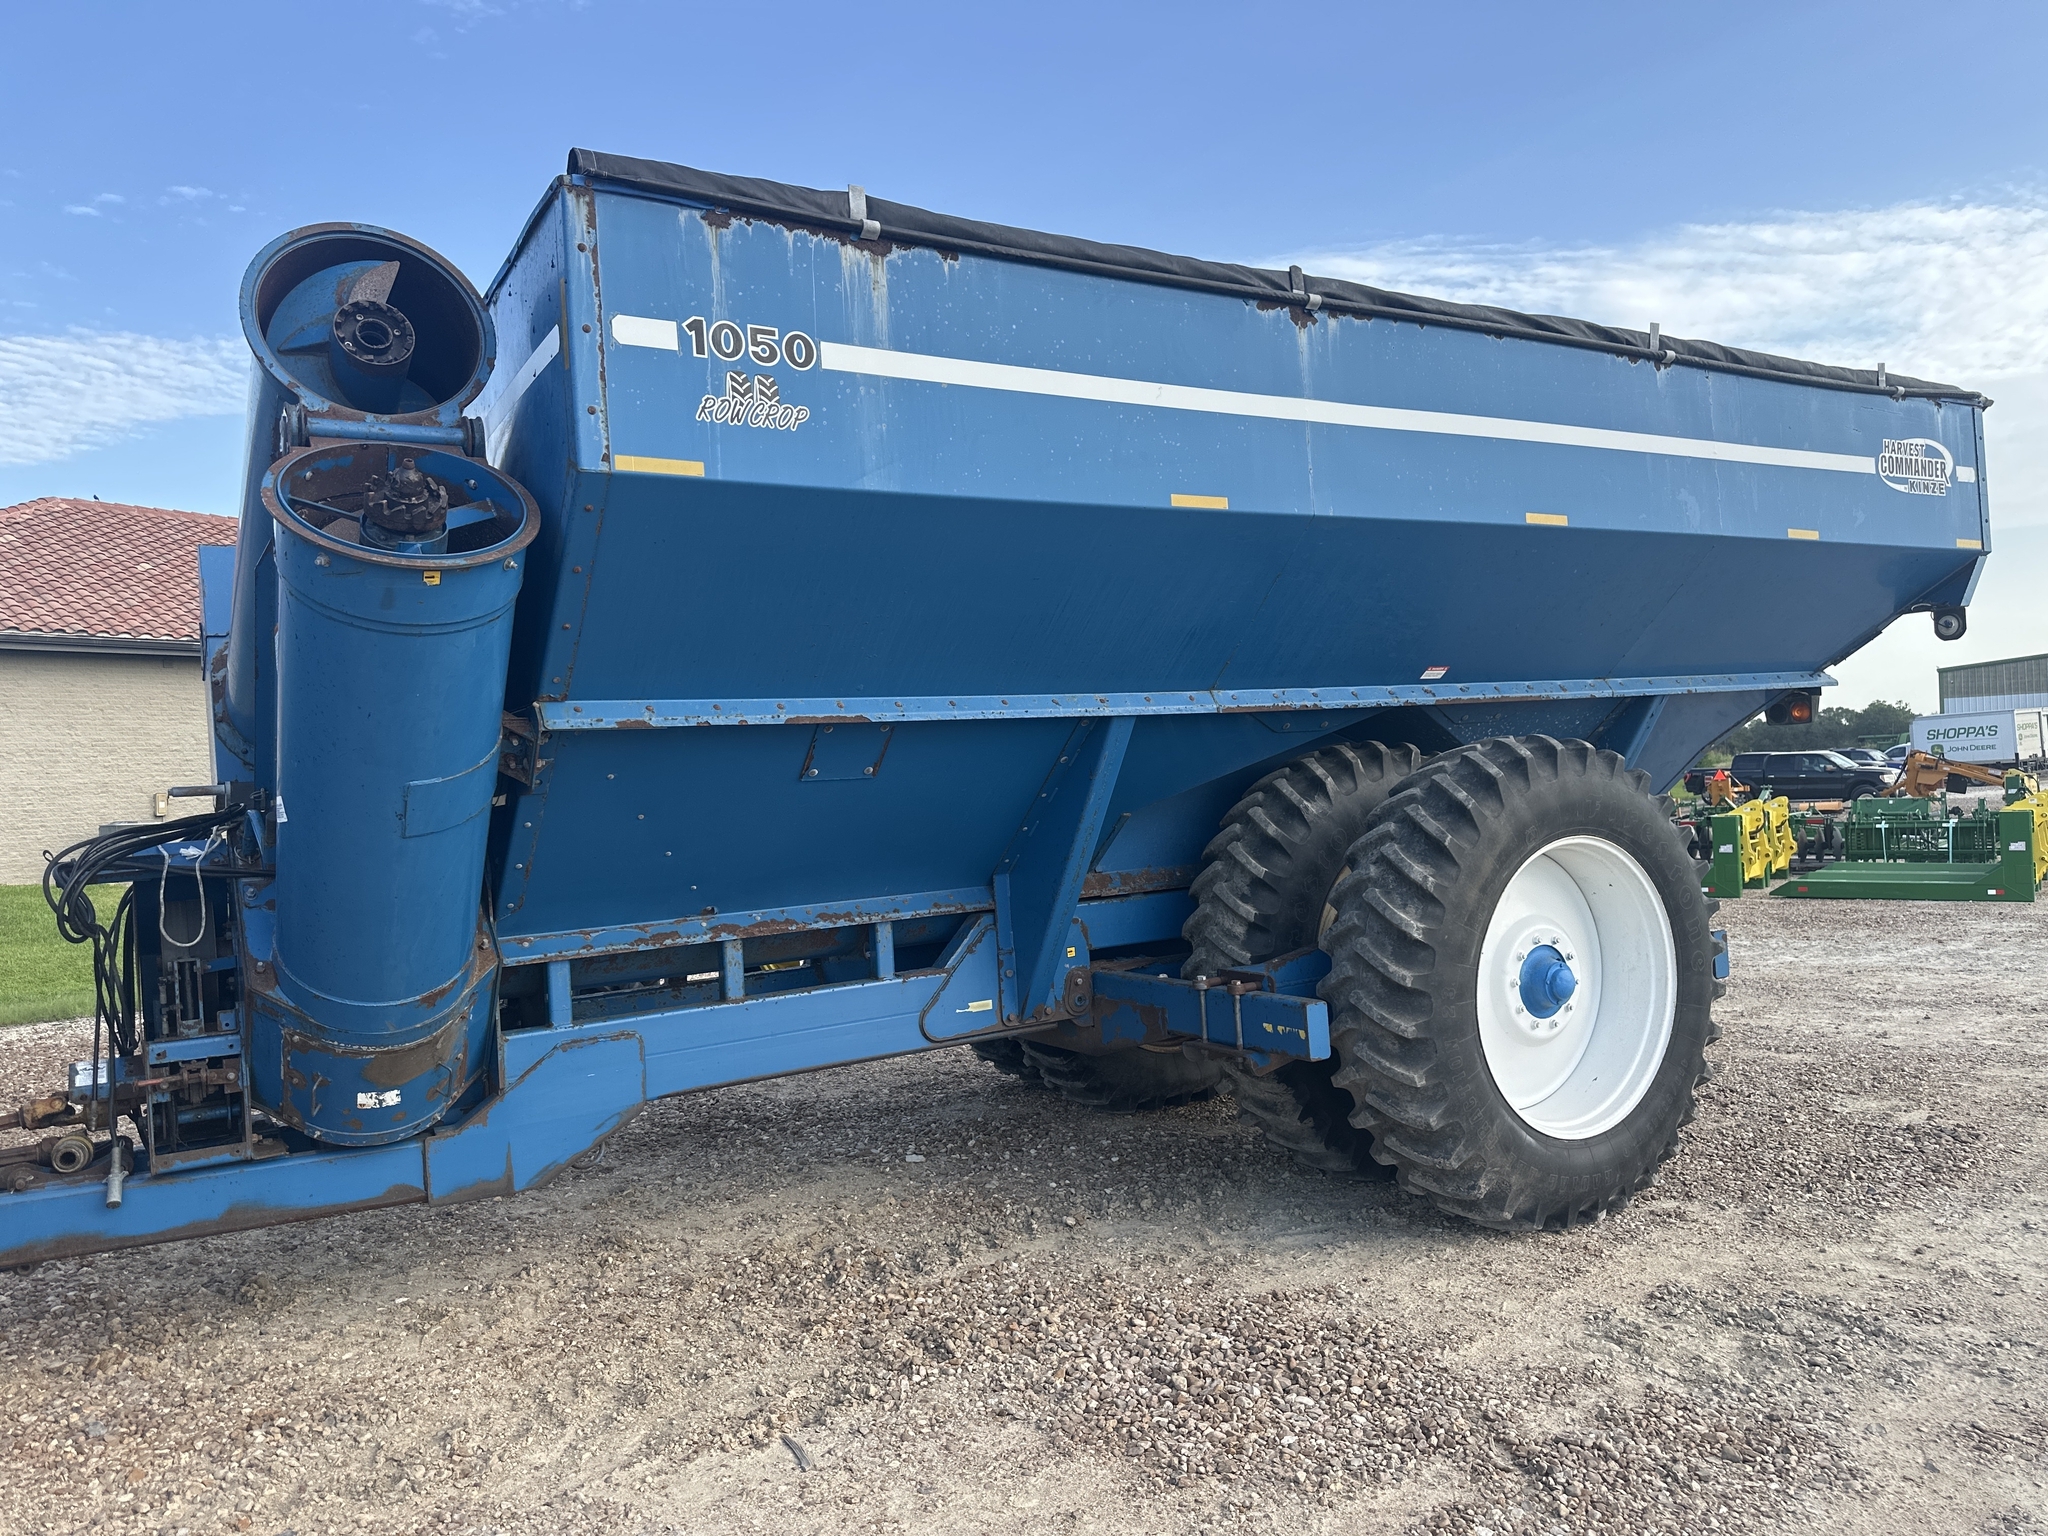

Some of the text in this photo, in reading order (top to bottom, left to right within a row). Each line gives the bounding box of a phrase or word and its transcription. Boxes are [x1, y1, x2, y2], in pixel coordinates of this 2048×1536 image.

[682, 316, 817, 371] 1050
[1883, 440, 1925, 457] HARVEST
[1880, 454, 1949, 484] COMMANDER
[1909, 480, 1946, 495] KINZE
[1926, 724, 1999, 741] SHOPPA'S
[1970, 744, 1997, 752] DEERE
